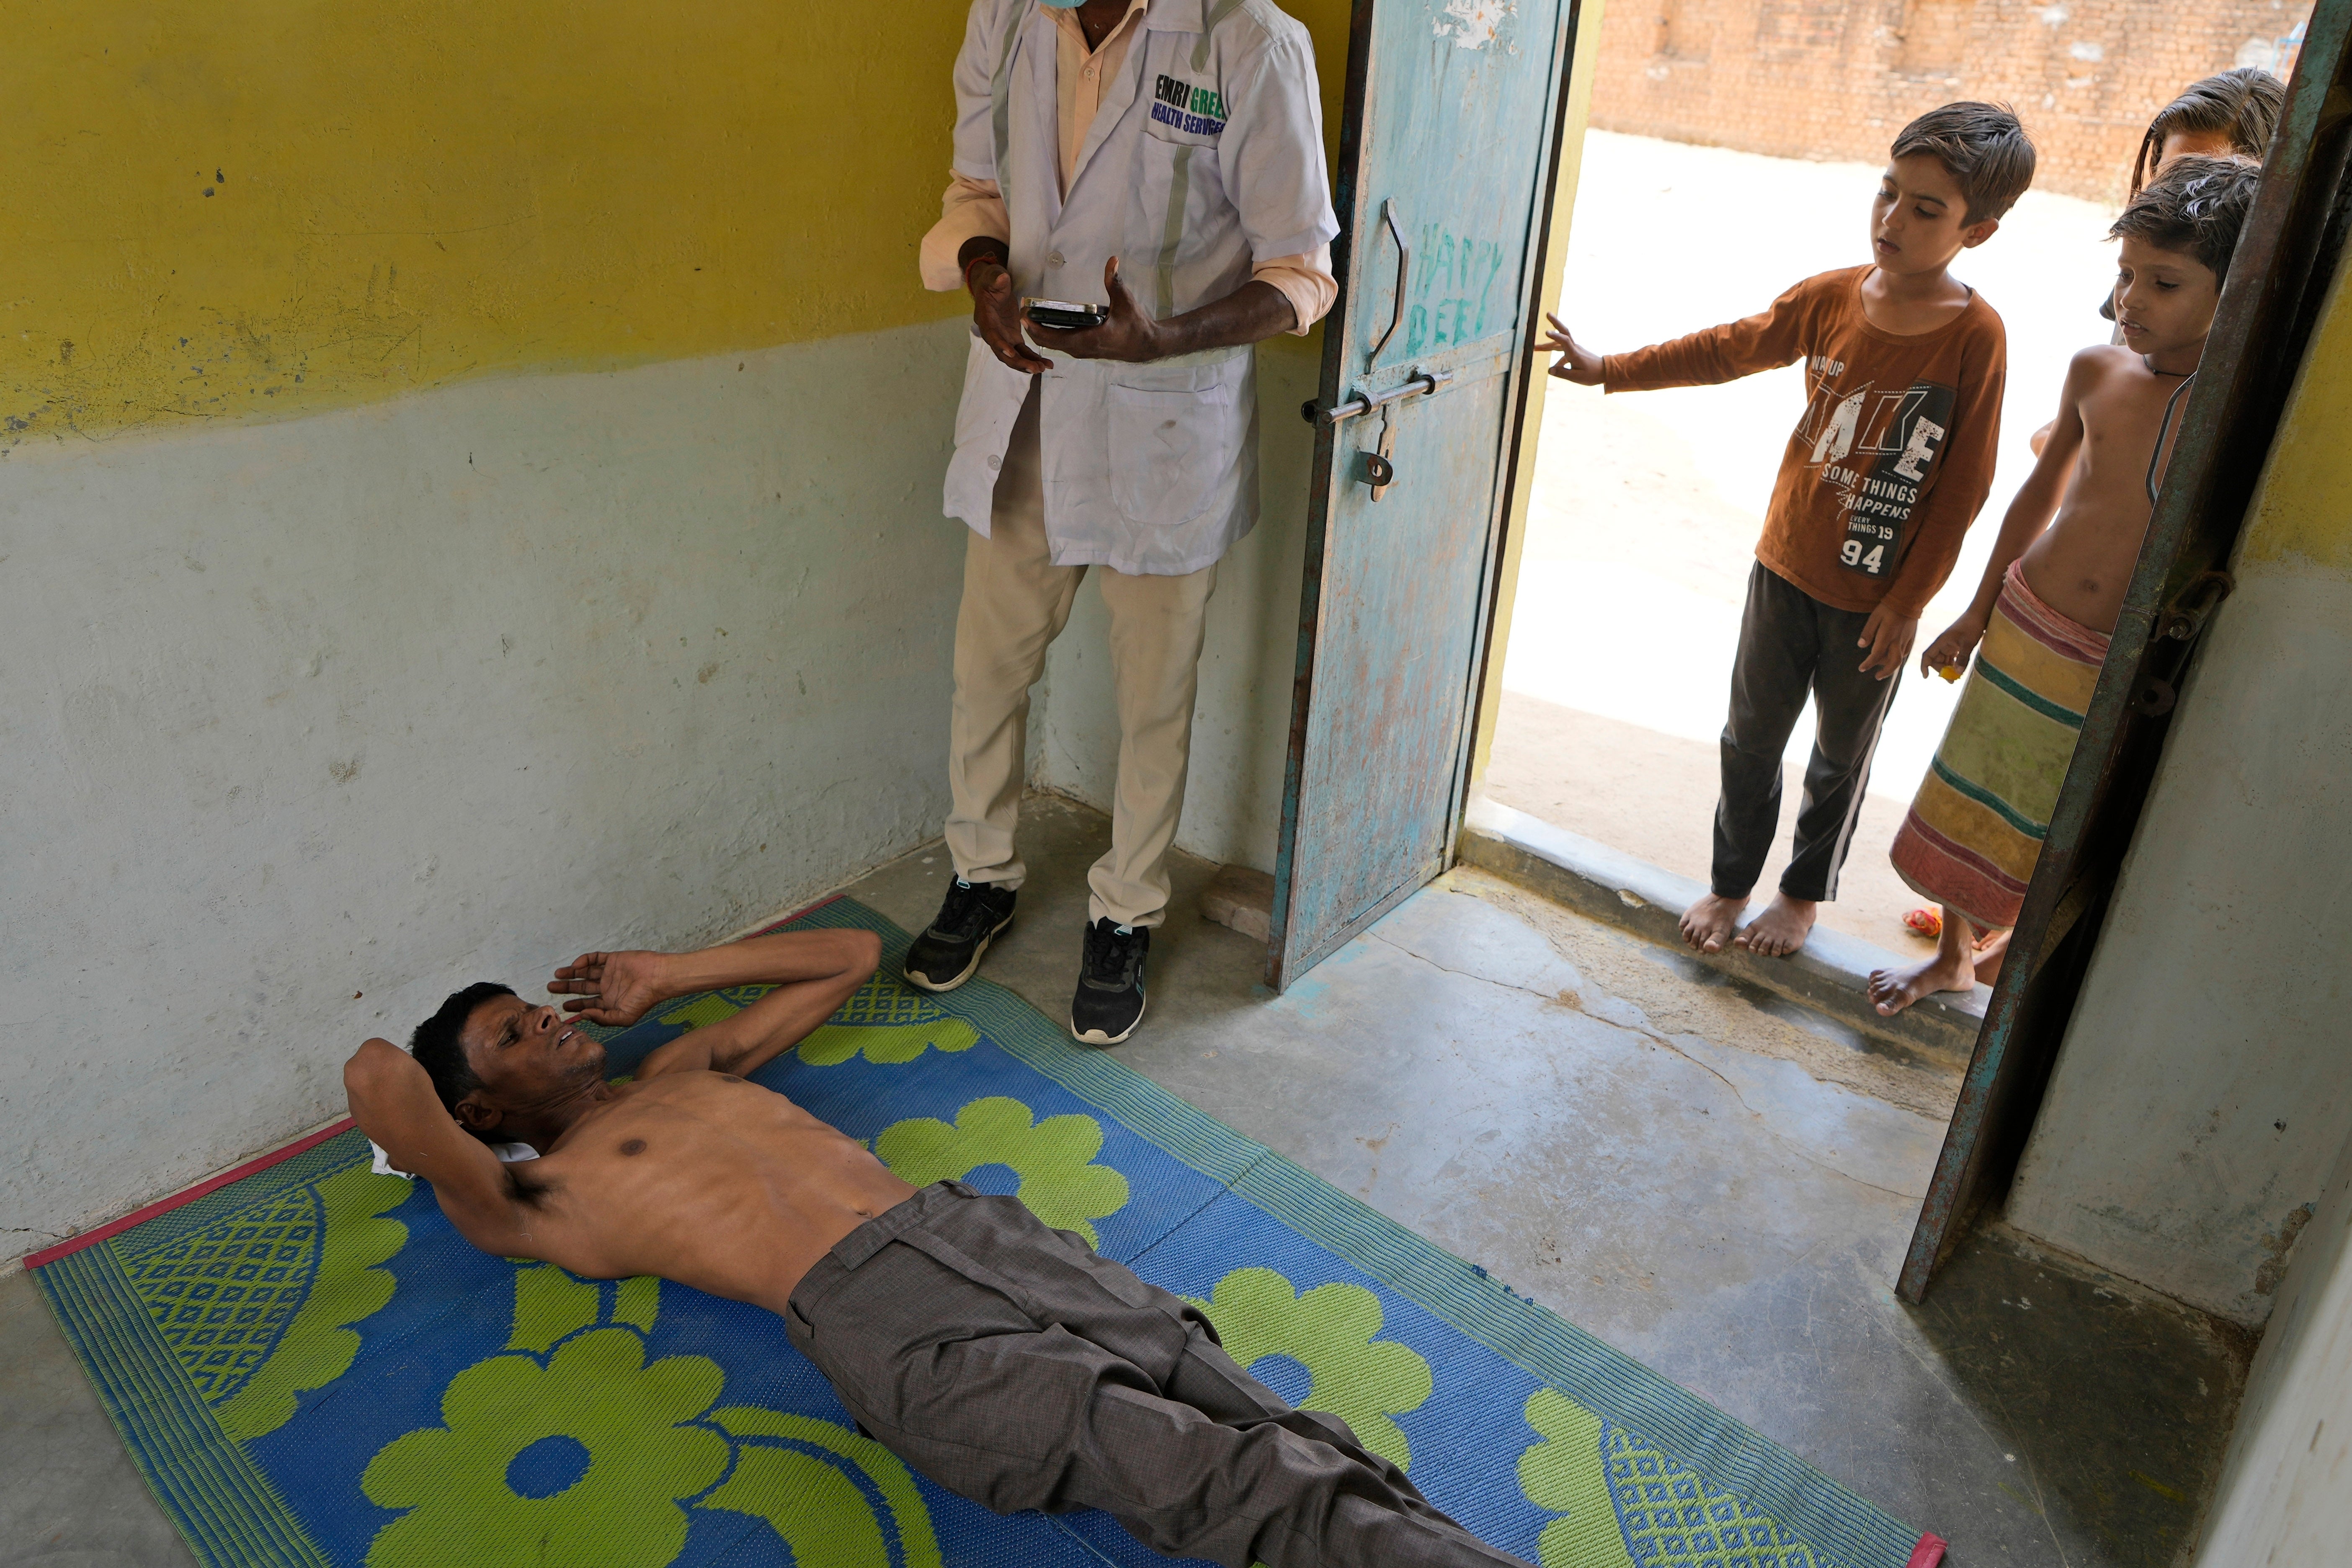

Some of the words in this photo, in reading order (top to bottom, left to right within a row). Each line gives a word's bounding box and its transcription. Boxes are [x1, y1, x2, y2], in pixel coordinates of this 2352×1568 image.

[1155, 74, 1190, 108] EMRI
[1151, 102, 1184, 129] HEALTH
[1415, 222, 1505, 336] HAPPY
[1822, 463, 1860, 488] SOME
[1862, 477, 1918, 504] THINGS
[1845, 493, 1911, 521] HAPPENS
[1849, 515, 1871, 524] EVERY
[1848, 522, 1877, 534] THINGS
[1877, 526, 1893, 540] 19
[1840, 539, 1885, 574] 94
